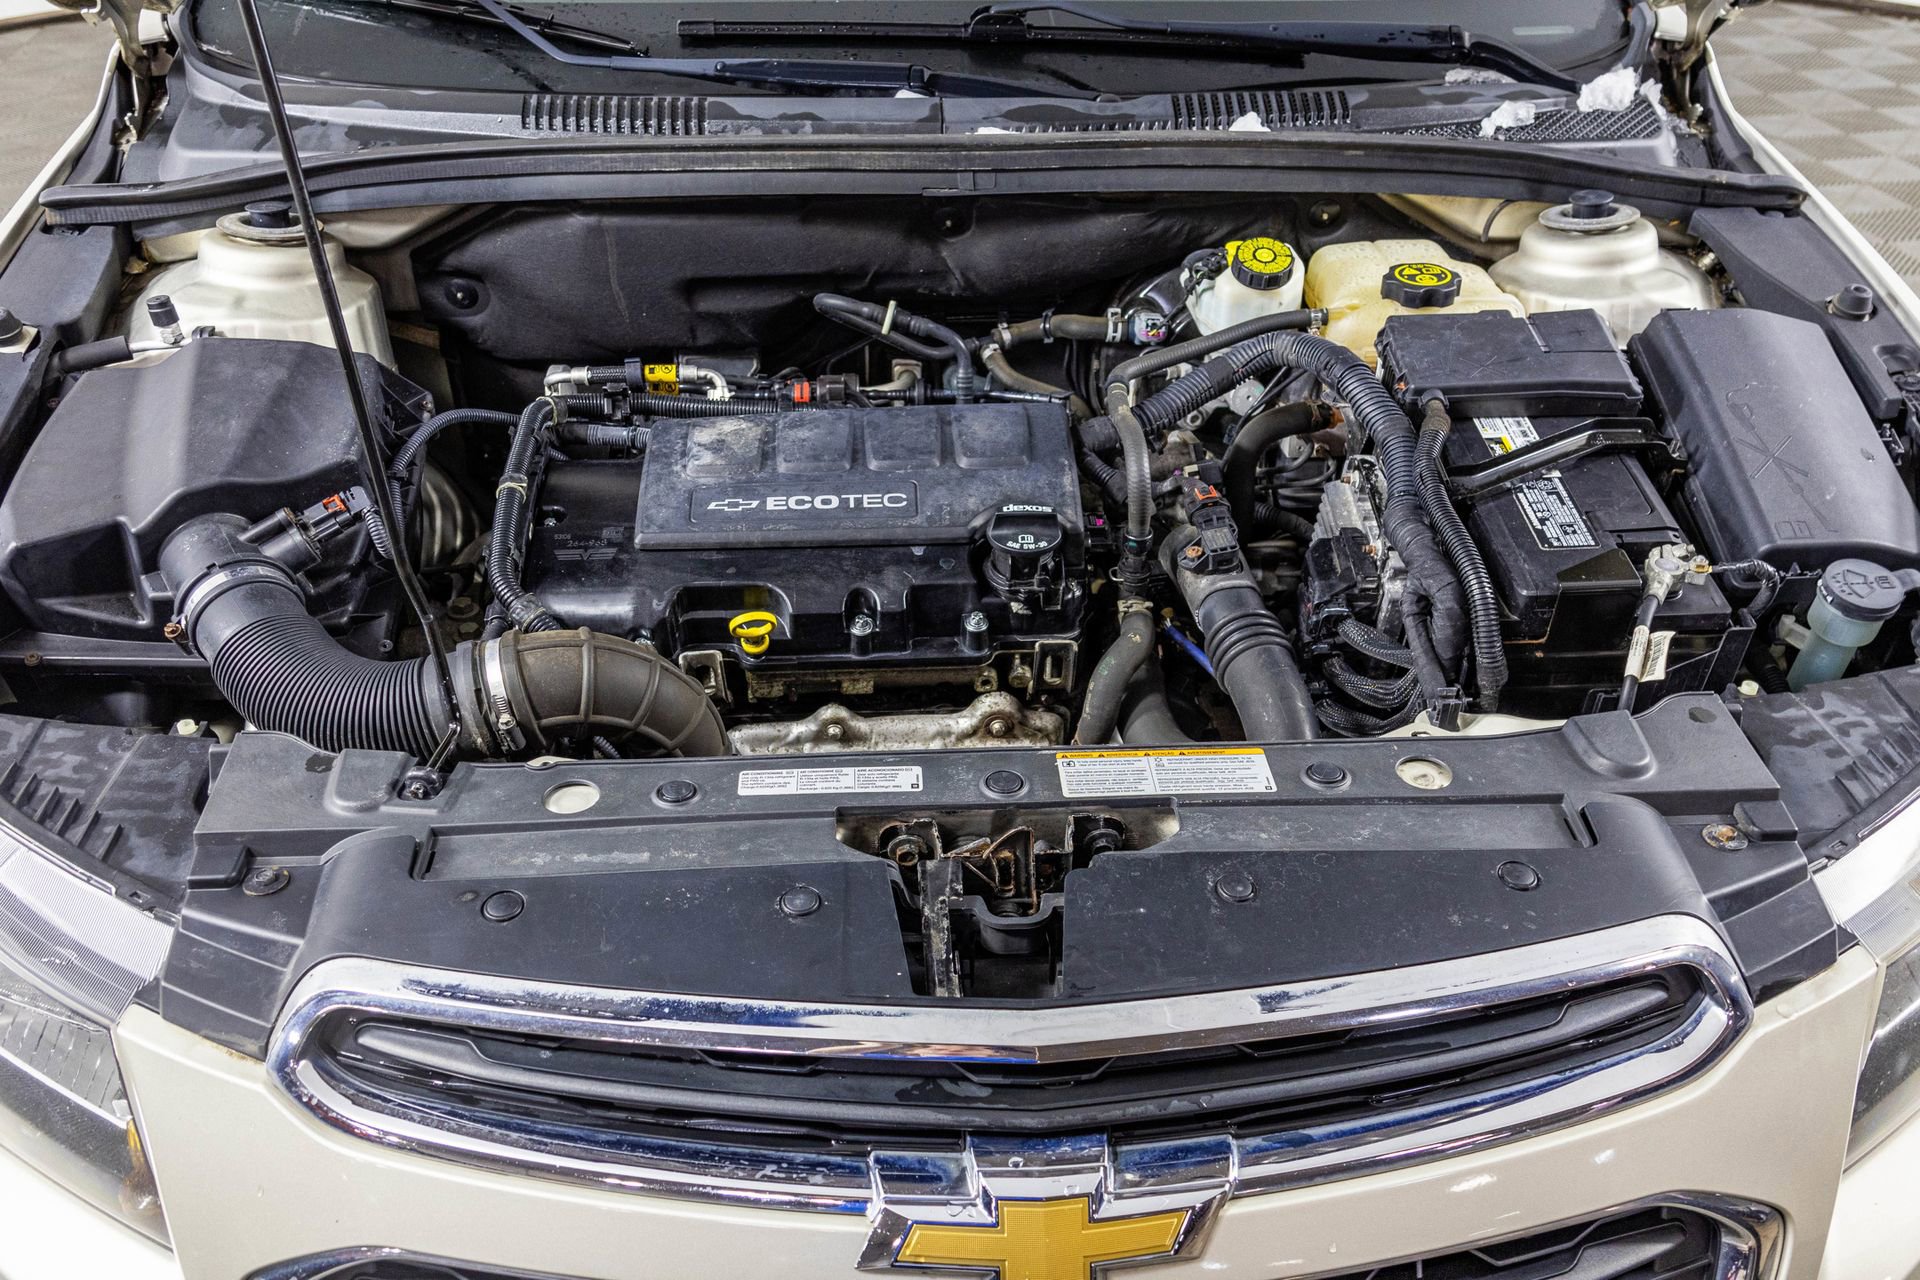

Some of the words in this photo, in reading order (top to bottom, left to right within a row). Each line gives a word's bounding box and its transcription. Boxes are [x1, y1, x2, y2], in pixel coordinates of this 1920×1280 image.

[766, 493, 908, 510] ECOTEC
[1002, 503, 1052, 512] dexos
[1006, 540, 1021, 549] SAE
[1023, 540, 1048, 549] 5W-30
